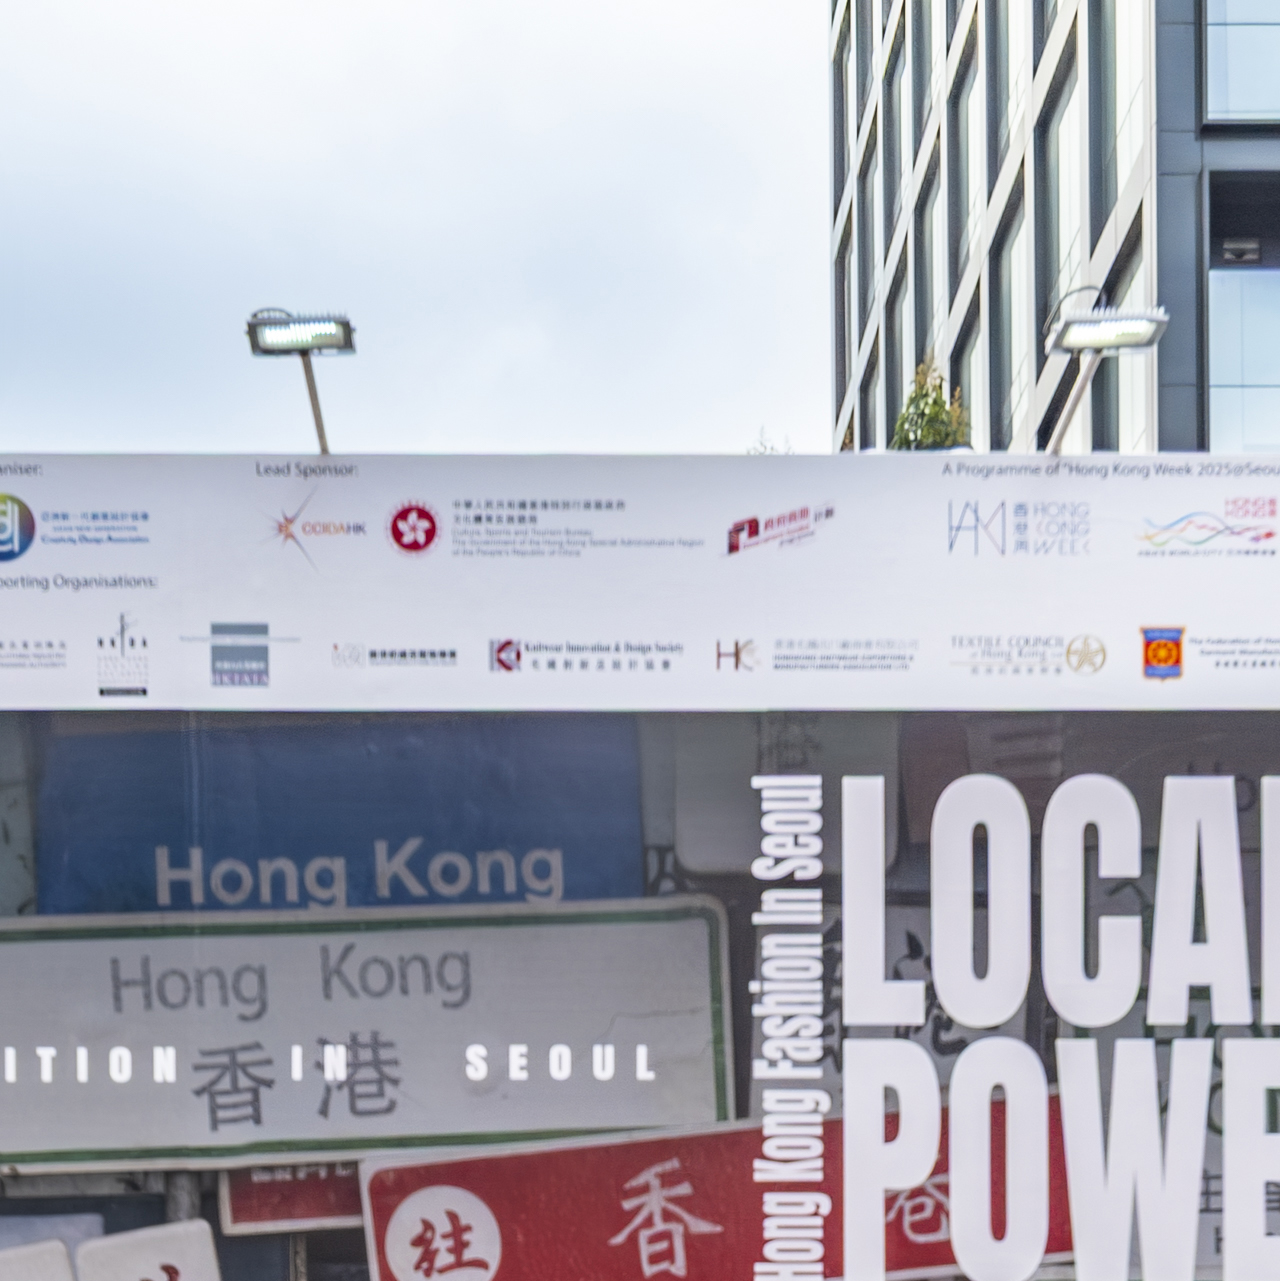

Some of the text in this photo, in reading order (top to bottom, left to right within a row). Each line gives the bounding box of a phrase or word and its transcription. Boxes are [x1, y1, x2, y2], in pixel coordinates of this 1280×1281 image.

[256, 461, 358, 479] Lead Sponsor:
[942, 462, 952, 476] A
[957, 462, 1040, 480] Programme
[1045, 461, 1060, 476] of
[1113, 462, 1150, 480] Kong
[1153, 462, 1192, 476] Week
[53, 574, 158, 592] Organisations:
[751, 774, 823, 882] Seoul
[154, 837, 565, 909] Hong Kong
[751, 885, 823, 925] In
[110, 943, 472, 1022] Hong Kong
[751, 931, 824, 1080] Fashion
[191, 1030, 402, 1132] 香港
[290, 1043, 348, 1082] IN
[464, 1042, 656, 1082] SEOUL
[752, 1089, 832, 1182] Kong
